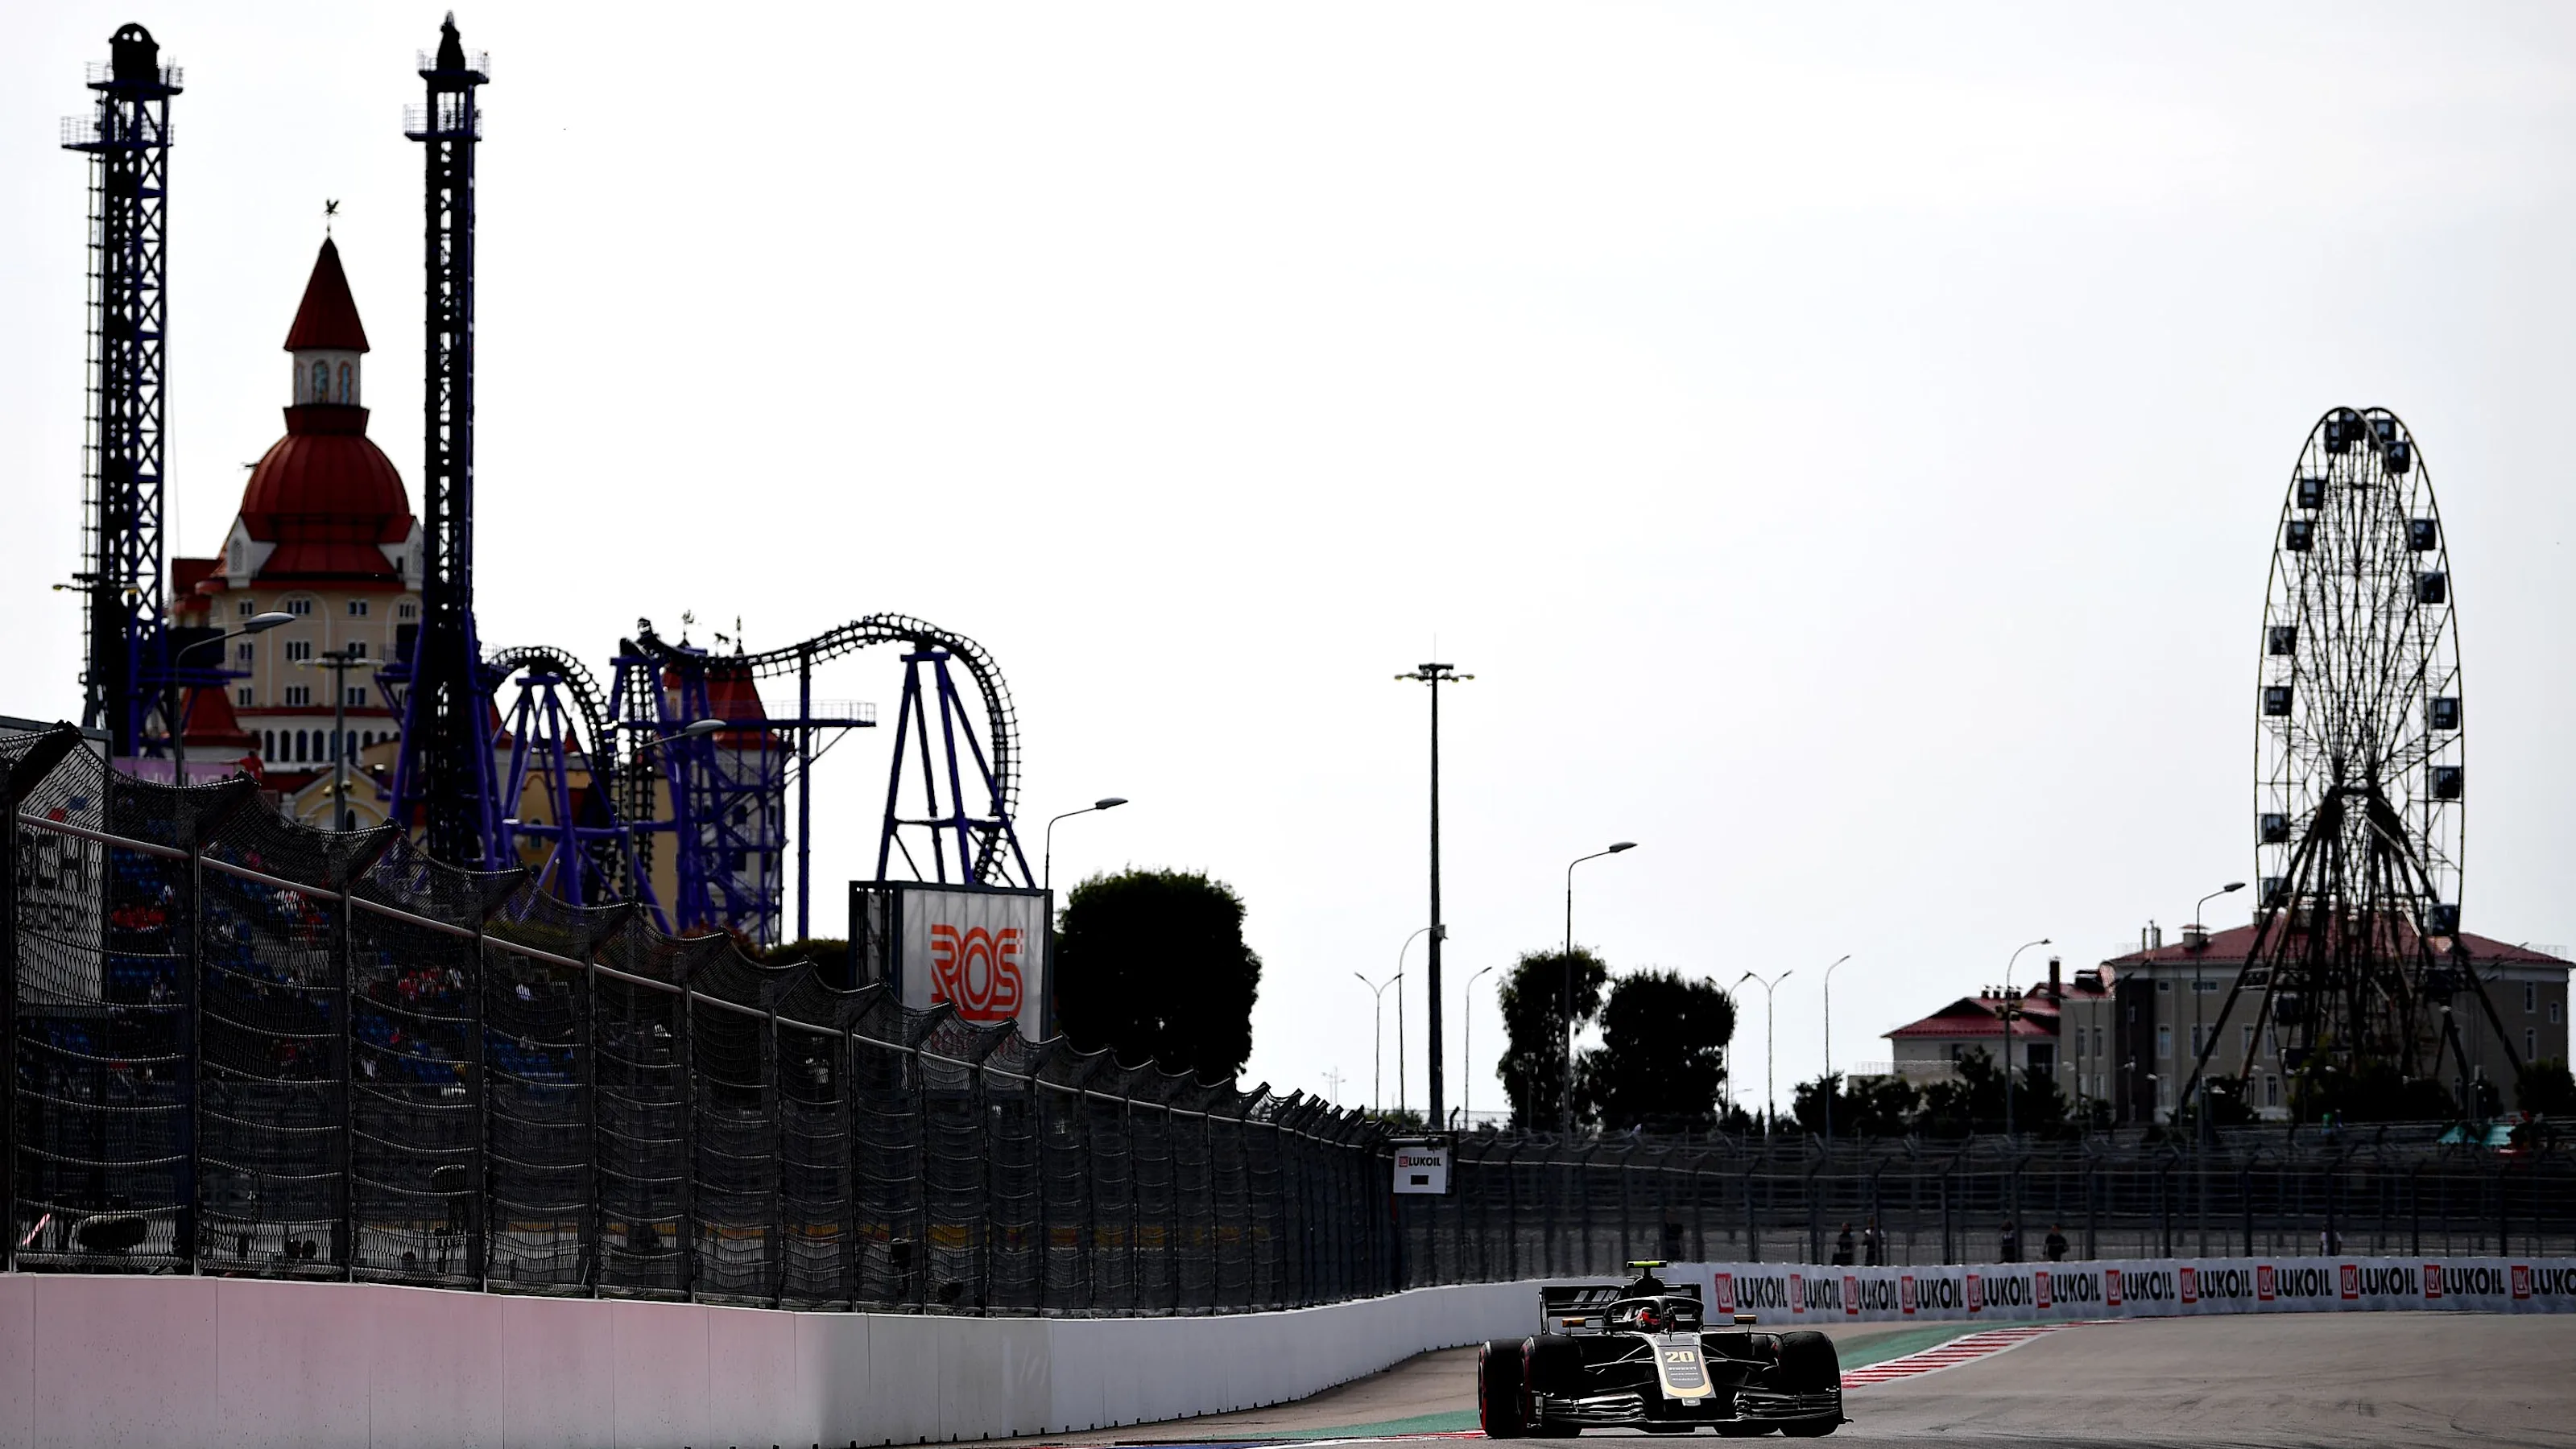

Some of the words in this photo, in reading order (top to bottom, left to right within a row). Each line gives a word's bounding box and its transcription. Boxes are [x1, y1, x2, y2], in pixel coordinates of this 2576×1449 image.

[931, 924, 1023, 1021] ROS
[1408, 1157, 1441, 1166] LUKOIL
[1734, 1276, 1788, 1309] LUKOIL
[1803, 1278, 1842, 1310] LUKOIL
[1857, 1279, 1898, 1310] LUKOIL
[1915, 1278, 1963, 1309] LUKOIL
[1982, 1276, 2032, 1307] LUKOIL
[2051, 1273, 2101, 1302] LUKOIL
[2122, 1271, 2174, 1301] LUKOIL
[2197, 1269, 2252, 1298] LUKOIL
[2275, 1268, 2333, 1297] LUKOIL
[2359, 1267, 2418, 1295] LUKOIL
[2442, 1267, 2506, 1295] LUKOIL
[2530, 1267, 2576, 1295] LUKO
[1665, 1351, 1695, 1363] 20
